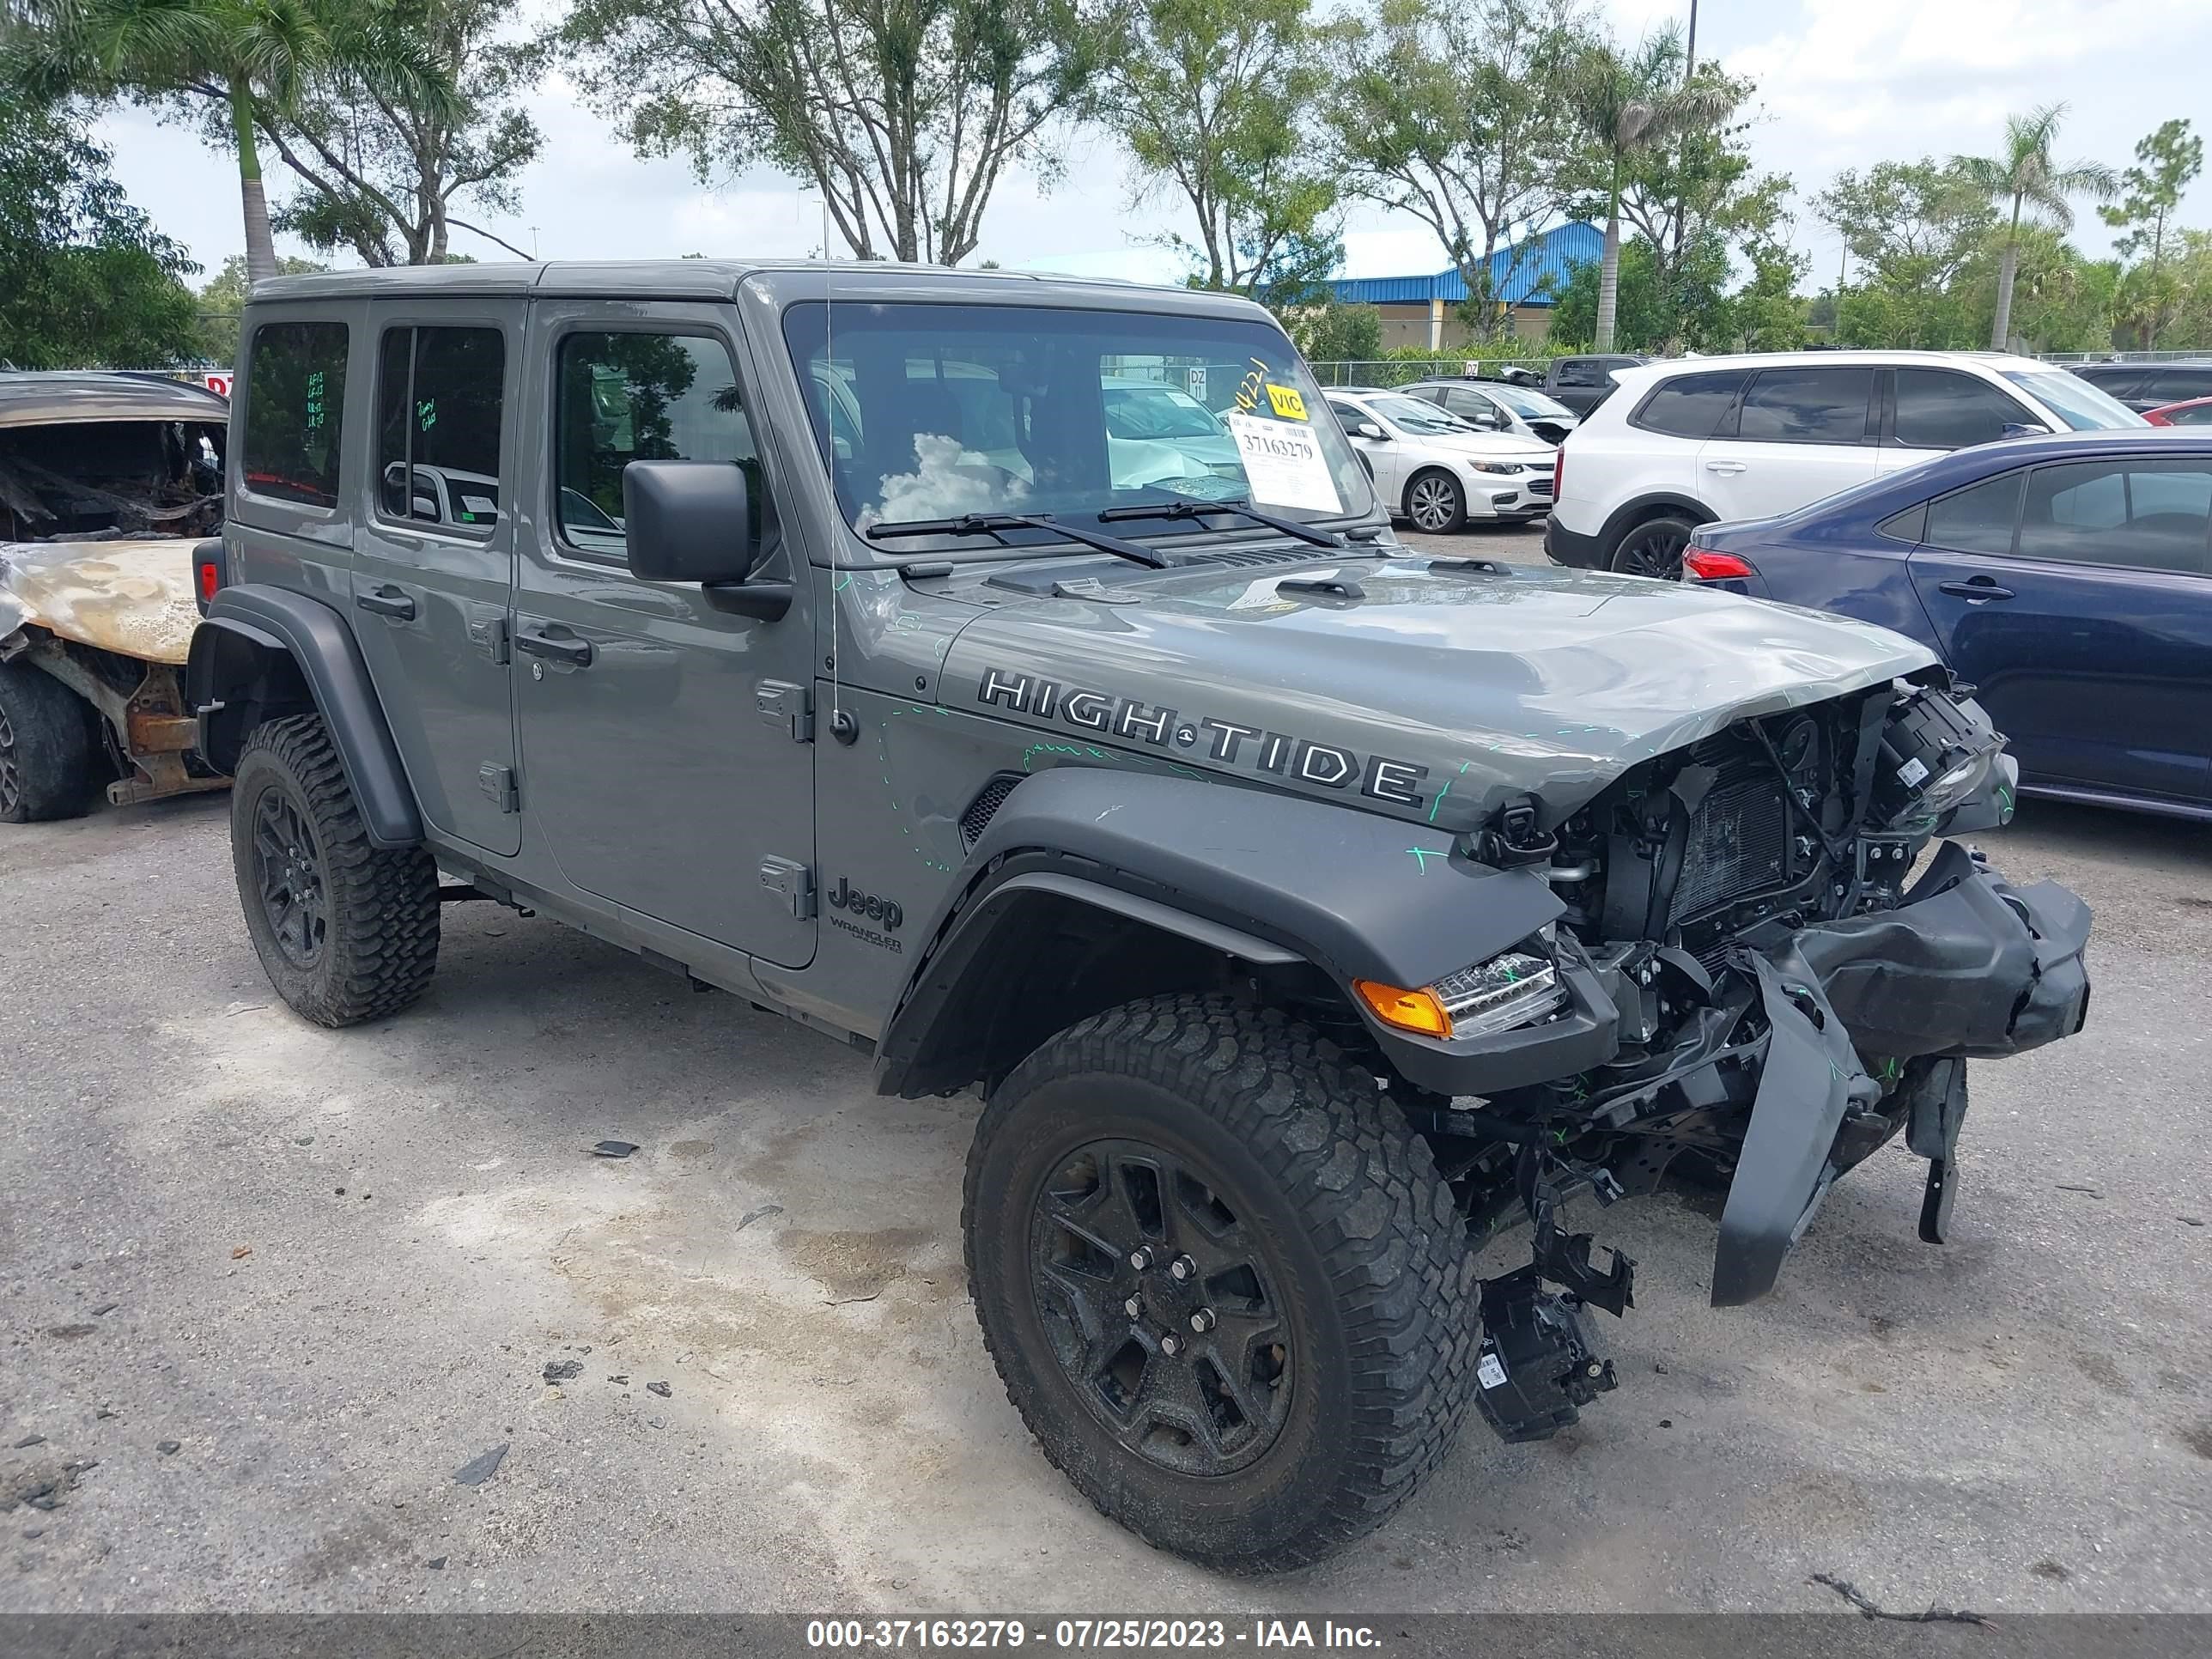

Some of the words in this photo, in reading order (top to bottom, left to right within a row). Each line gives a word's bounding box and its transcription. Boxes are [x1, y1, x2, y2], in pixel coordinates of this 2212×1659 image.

[1191, 370, 1206, 384] DZ
[1467, 363, 1478, 375] DZ
[1194, 385, 1201, 399] 11
[1271, 392, 1302, 412] VIC
[1243, 434, 1313, 460] 37163279
[978, 666, 1177, 747] HIGH
[1201, 716, 1430, 809] TIDE
[827, 875, 903, 933] Jeep
[830, 915, 902, 950] WRANGLER
[851, 932, 903, 955] UNLIMITED
